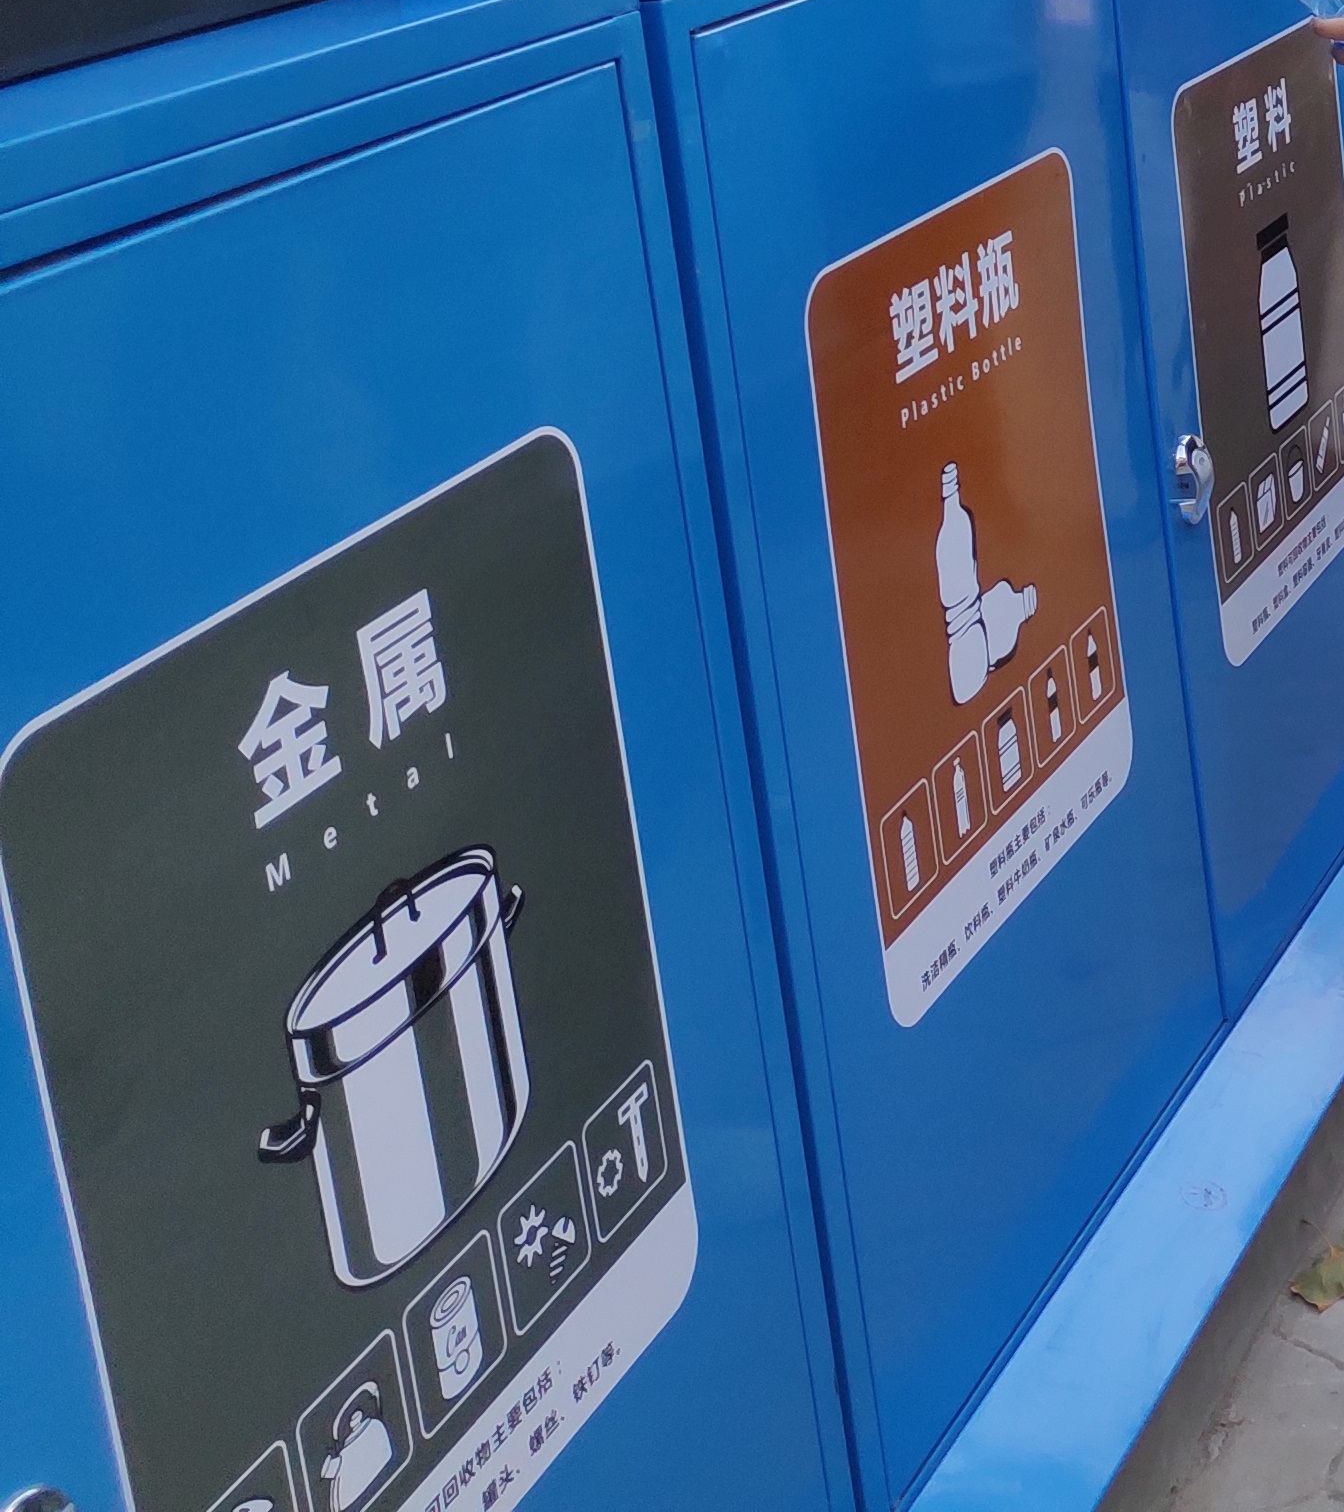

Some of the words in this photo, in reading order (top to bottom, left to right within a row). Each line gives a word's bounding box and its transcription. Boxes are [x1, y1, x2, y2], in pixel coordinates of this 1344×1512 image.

[1232, 77, 1292, 175] 塑料
[889, 230, 1020, 385] 塑料瓶
[900, 374, 964, 430] Plastic
[971, 335, 1024, 381] Bottle
[237, 587, 447, 830] 金属
[264, 732, 455, 892] Metal
